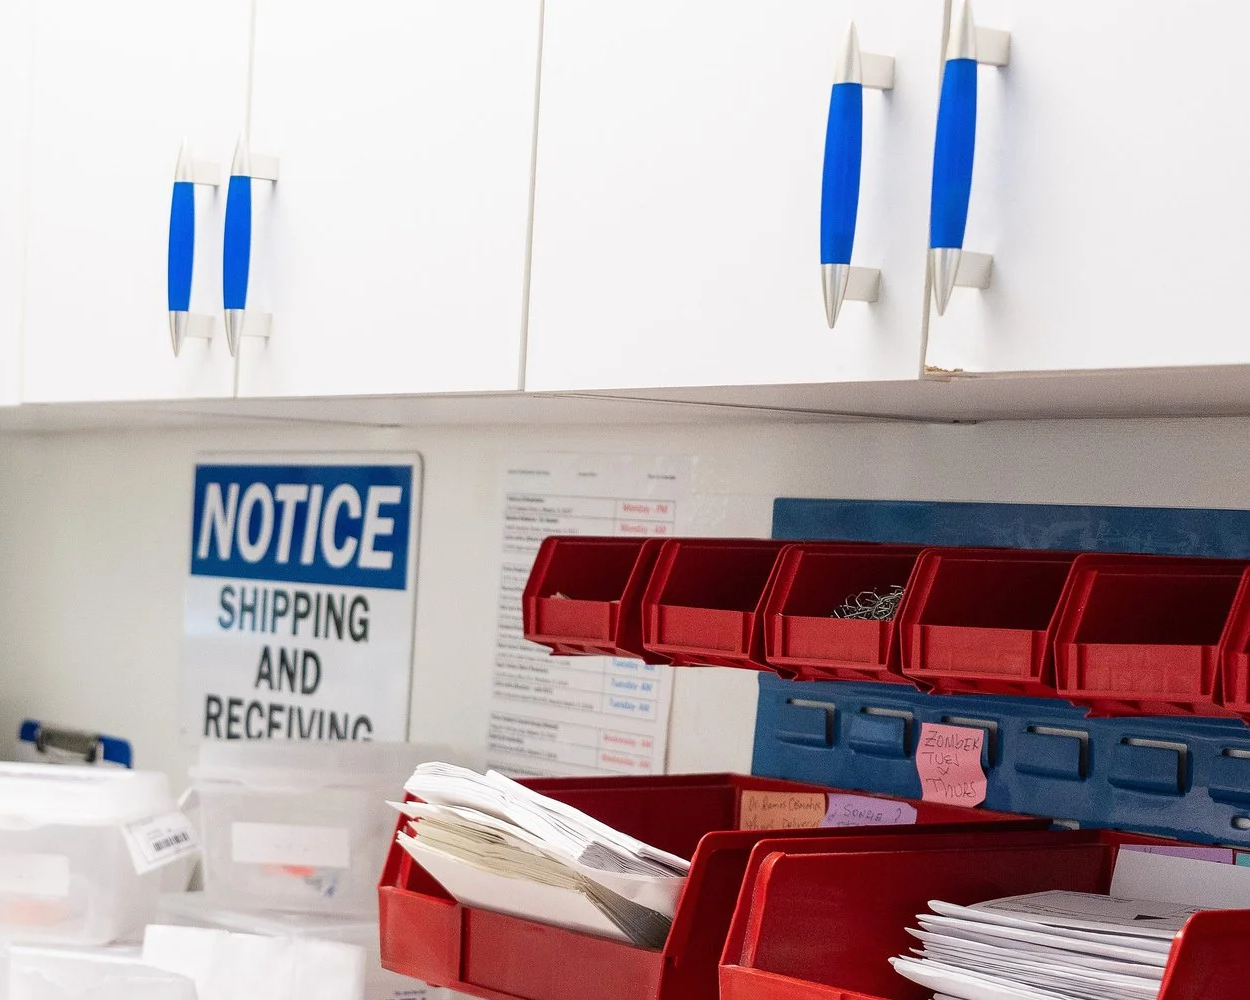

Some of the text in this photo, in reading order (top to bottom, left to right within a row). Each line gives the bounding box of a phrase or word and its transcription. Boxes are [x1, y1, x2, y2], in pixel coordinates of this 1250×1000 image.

[198, 482, 402, 570] NOTICE
[218, 584, 370, 642] SHIPPING
[255, 645, 321, 695] AND
